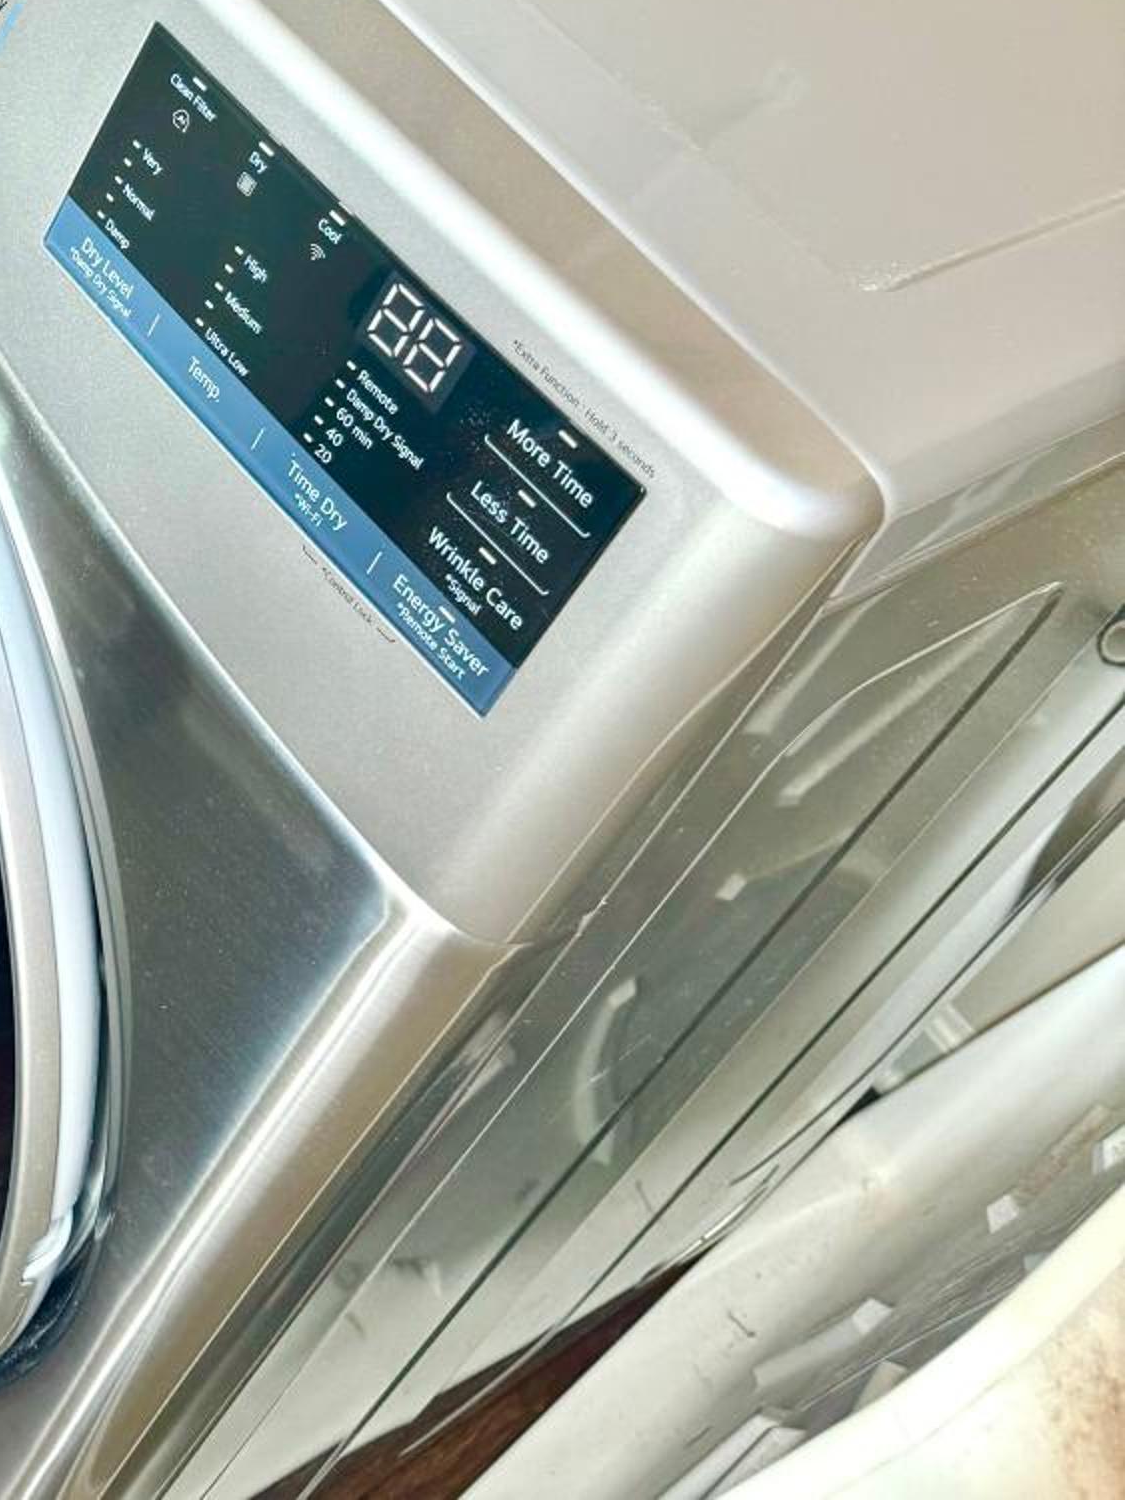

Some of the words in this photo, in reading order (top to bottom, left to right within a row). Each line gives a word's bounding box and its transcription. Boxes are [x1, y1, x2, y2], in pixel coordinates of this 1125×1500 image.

[170, 73, 194, 101] Clean
[193, 95, 217, 122] Filter
[142, 148, 163, 175] Very
[248, 151, 267, 174] Dry
[122, 183, 155, 220] Normal
[104, 219, 130, 249] Damp
[317, 218, 343, 244] Cool
[82, 237, 104, 267] Dry
[102, 260, 134, 299] Level
[243, 254, 267, 283] High
[92, 274, 108, 295] Dry
[106, 290, 132, 317] Signal
[224, 291, 263, 335] Medium
[205, 327, 228, 357] Ultra
[227, 351, 250, 378] Low
[366, 282, 463, 394] 88
[187, 355, 220, 402] Temp.
[357, 369, 399, 415] Remote
[325, 428, 344, 448] 40
[336, 407, 354, 428] 60
[351, 425, 373, 450] min
[346, 388, 374, 421] Damp
[374, 415, 394, 441] Dry
[391, 435, 424, 470] Signal
[539, 366, 580, 407] Function
[583, 407, 610, 434] Hold
[618, 440, 657, 479] seconds
[314, 443, 333, 464] 20
[506, 418, 551, 468] More
[549, 460, 594, 509] Time
[286, 459, 320, 502] Time
[320, 497, 348, 531] Dry
[470, 480, 508, 524] Less
[508, 516, 550, 565] Time
[427, 525, 485, 591] Wrinkle
[485, 586, 524, 631] Care
[392, 573, 446, 633] Energy
[443, 628, 490, 677] Saver
[436, 646, 467, 681] Start
